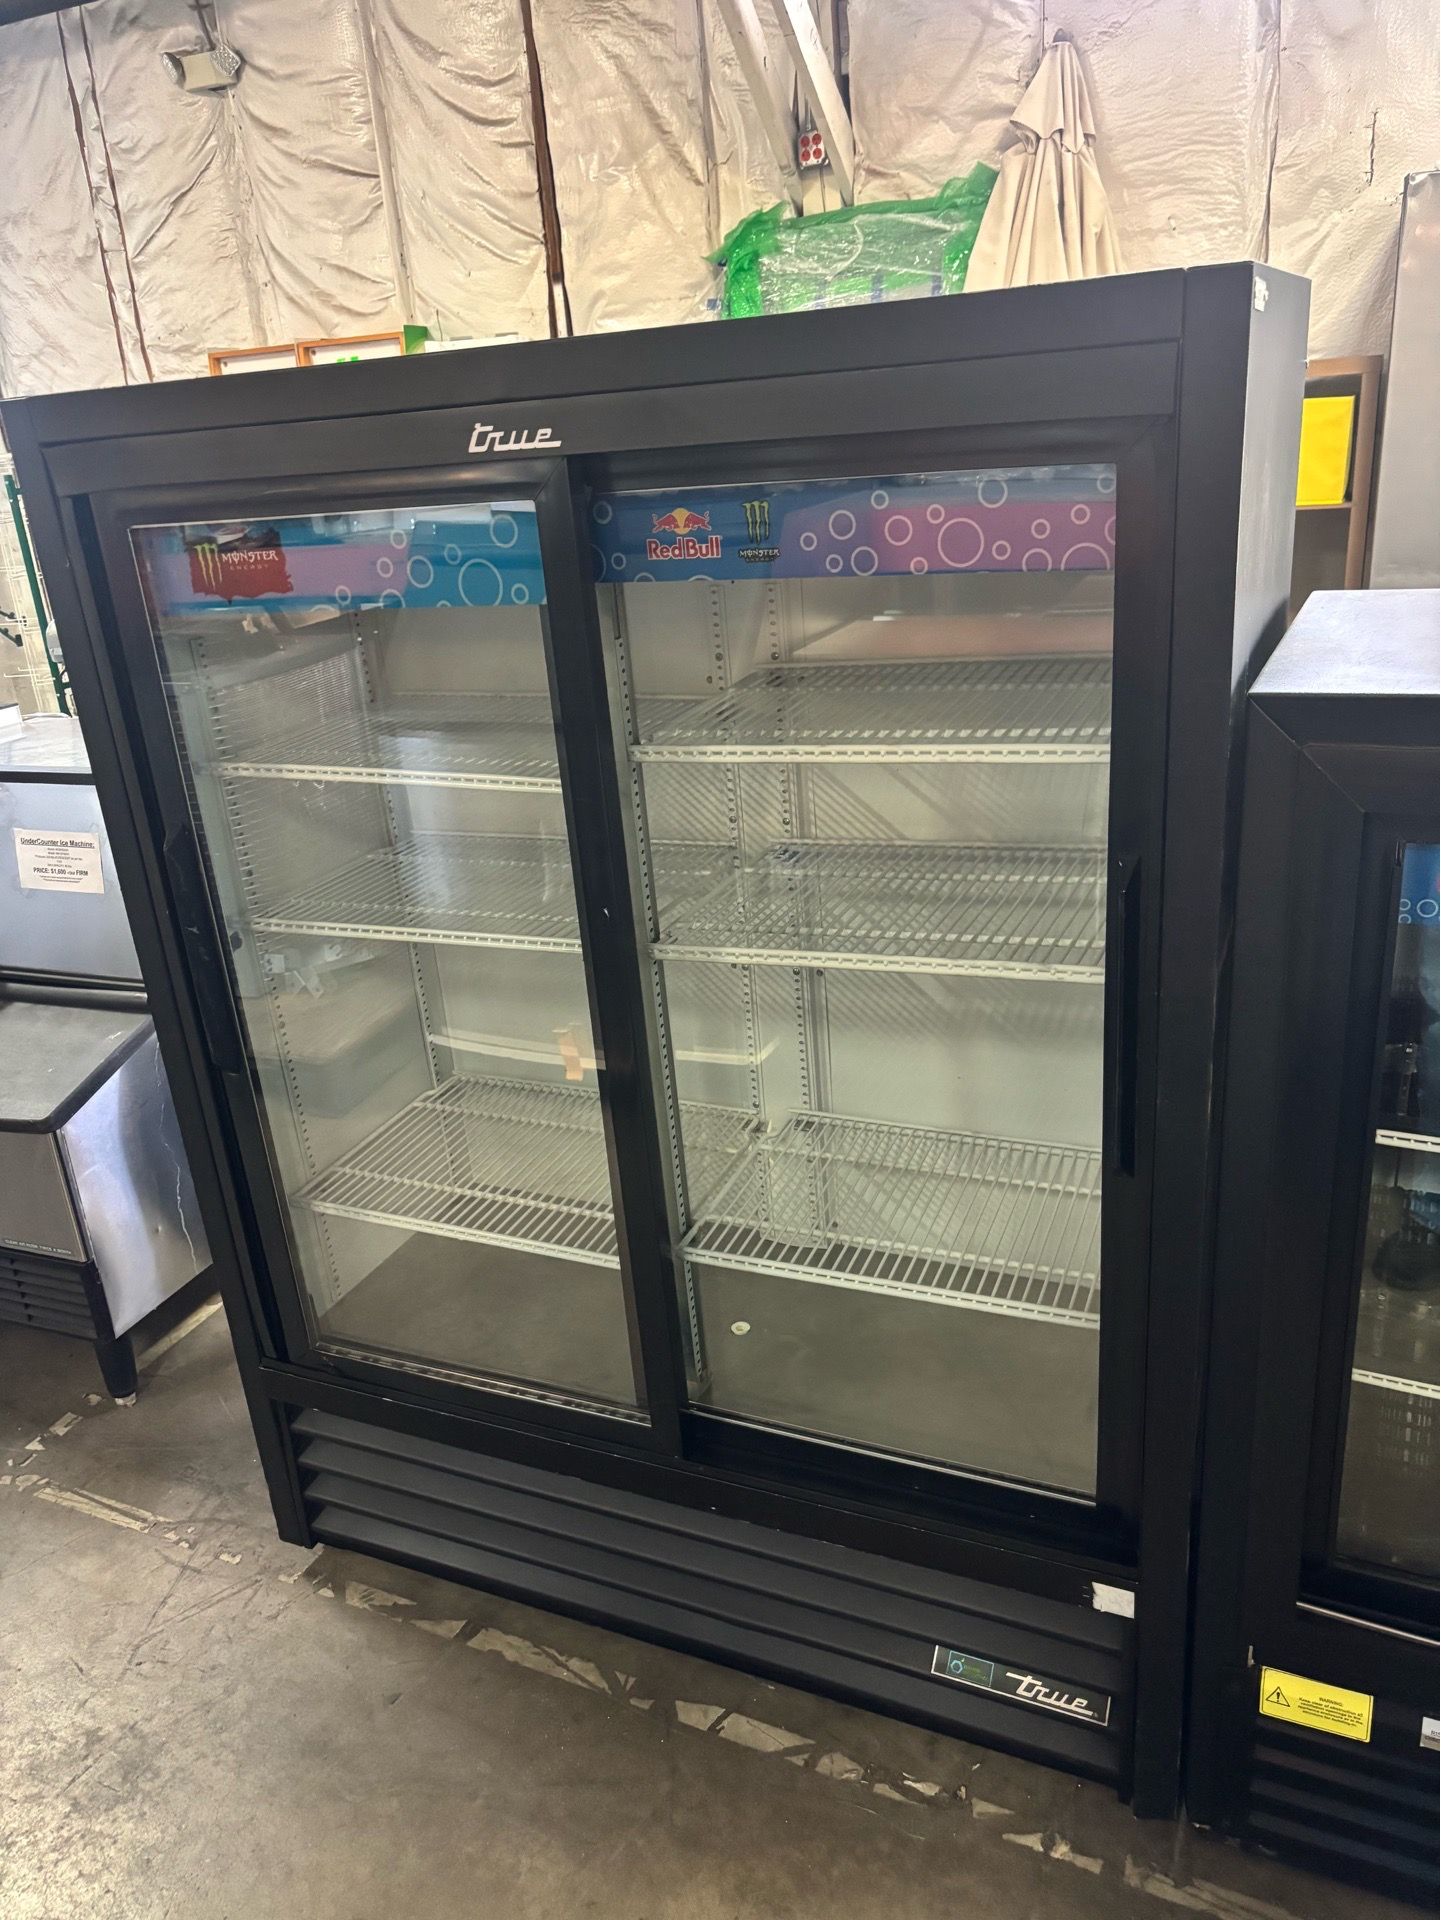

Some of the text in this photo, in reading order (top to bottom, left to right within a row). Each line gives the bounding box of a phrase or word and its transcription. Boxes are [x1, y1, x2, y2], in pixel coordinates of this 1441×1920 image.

[468, 423, 562, 453] true
[221, 550, 279, 565] MONSTER
[646, 535, 721, 560] Red Bull
[739, 548, 780, 558] MONSTER
[20, 837, 59, 846] UnderCounter
[60, 839, 69, 847] Ice
[1005, 1671, 1094, 1716] true
